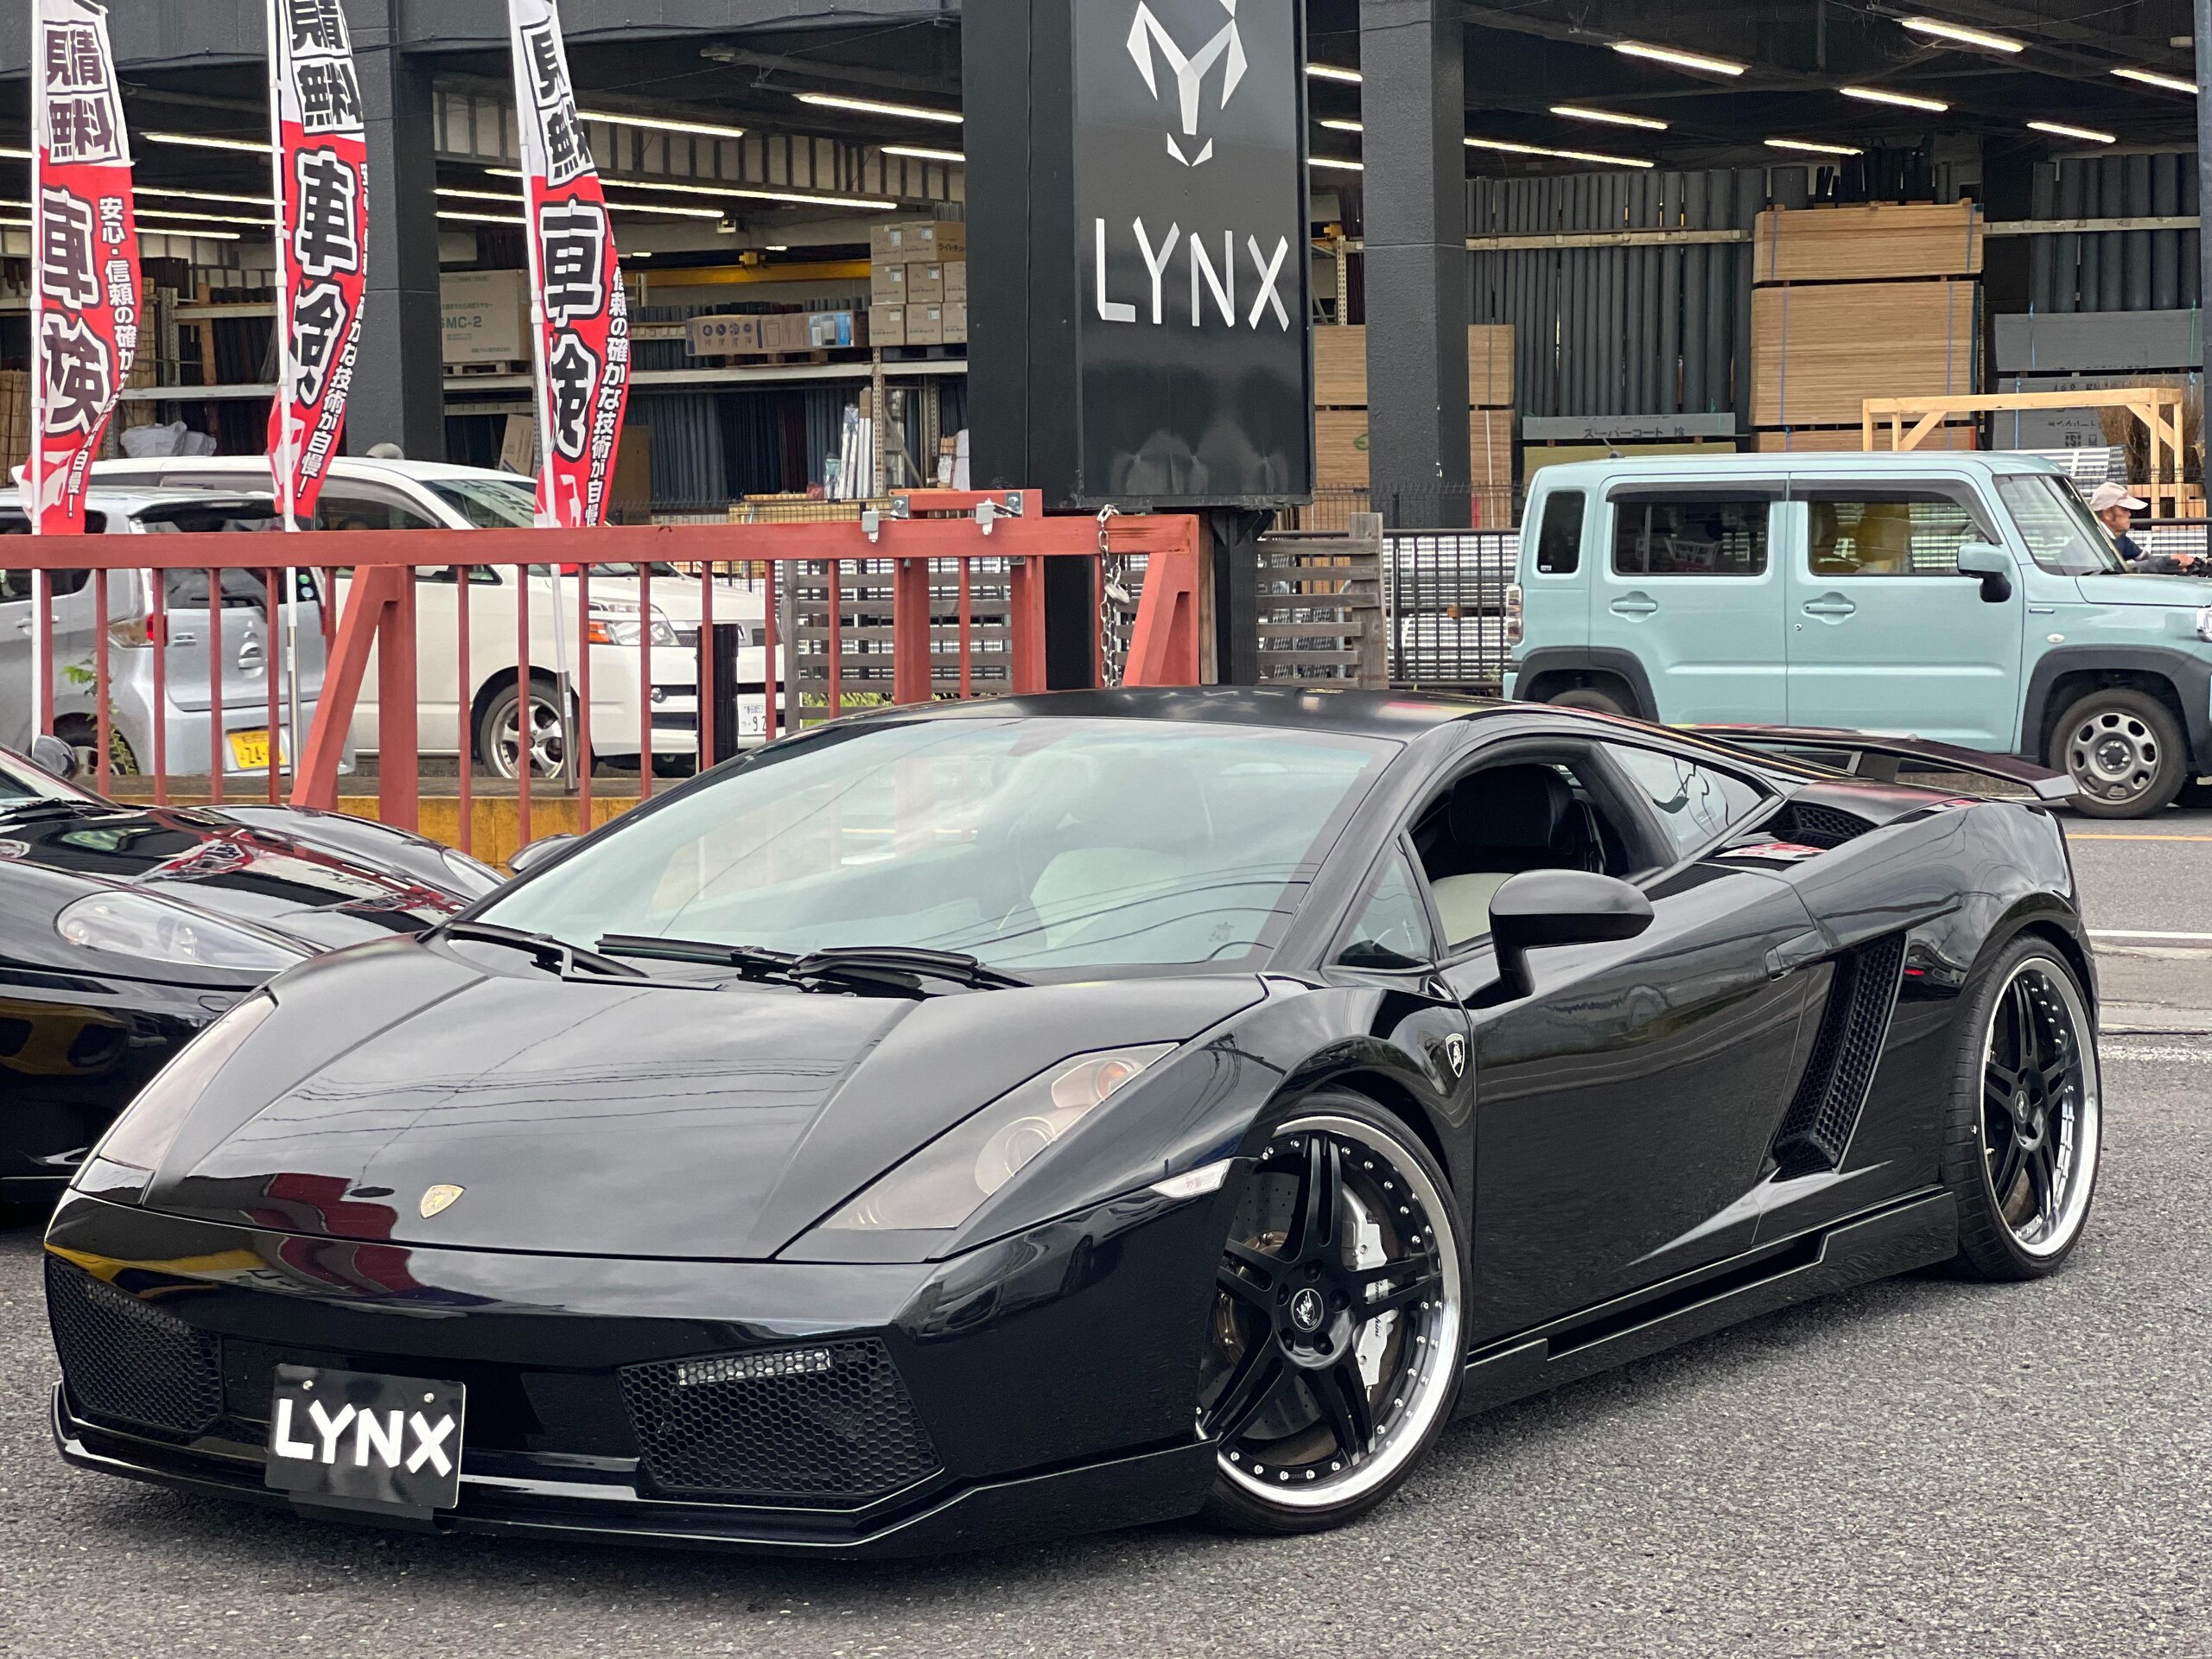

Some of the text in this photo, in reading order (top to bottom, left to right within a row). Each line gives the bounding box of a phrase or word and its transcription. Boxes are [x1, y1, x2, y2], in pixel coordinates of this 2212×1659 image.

[46, 29, 104, 86] 見積
[531, 29, 567, 99] 見
[48, 97, 112, 157] 無料
[296, 62, 363, 127] 無料
[1096, 216, 1290, 332] LYNX
[41, 185, 110, 436] 車検
[275, 1398, 456, 1478] LYNX
